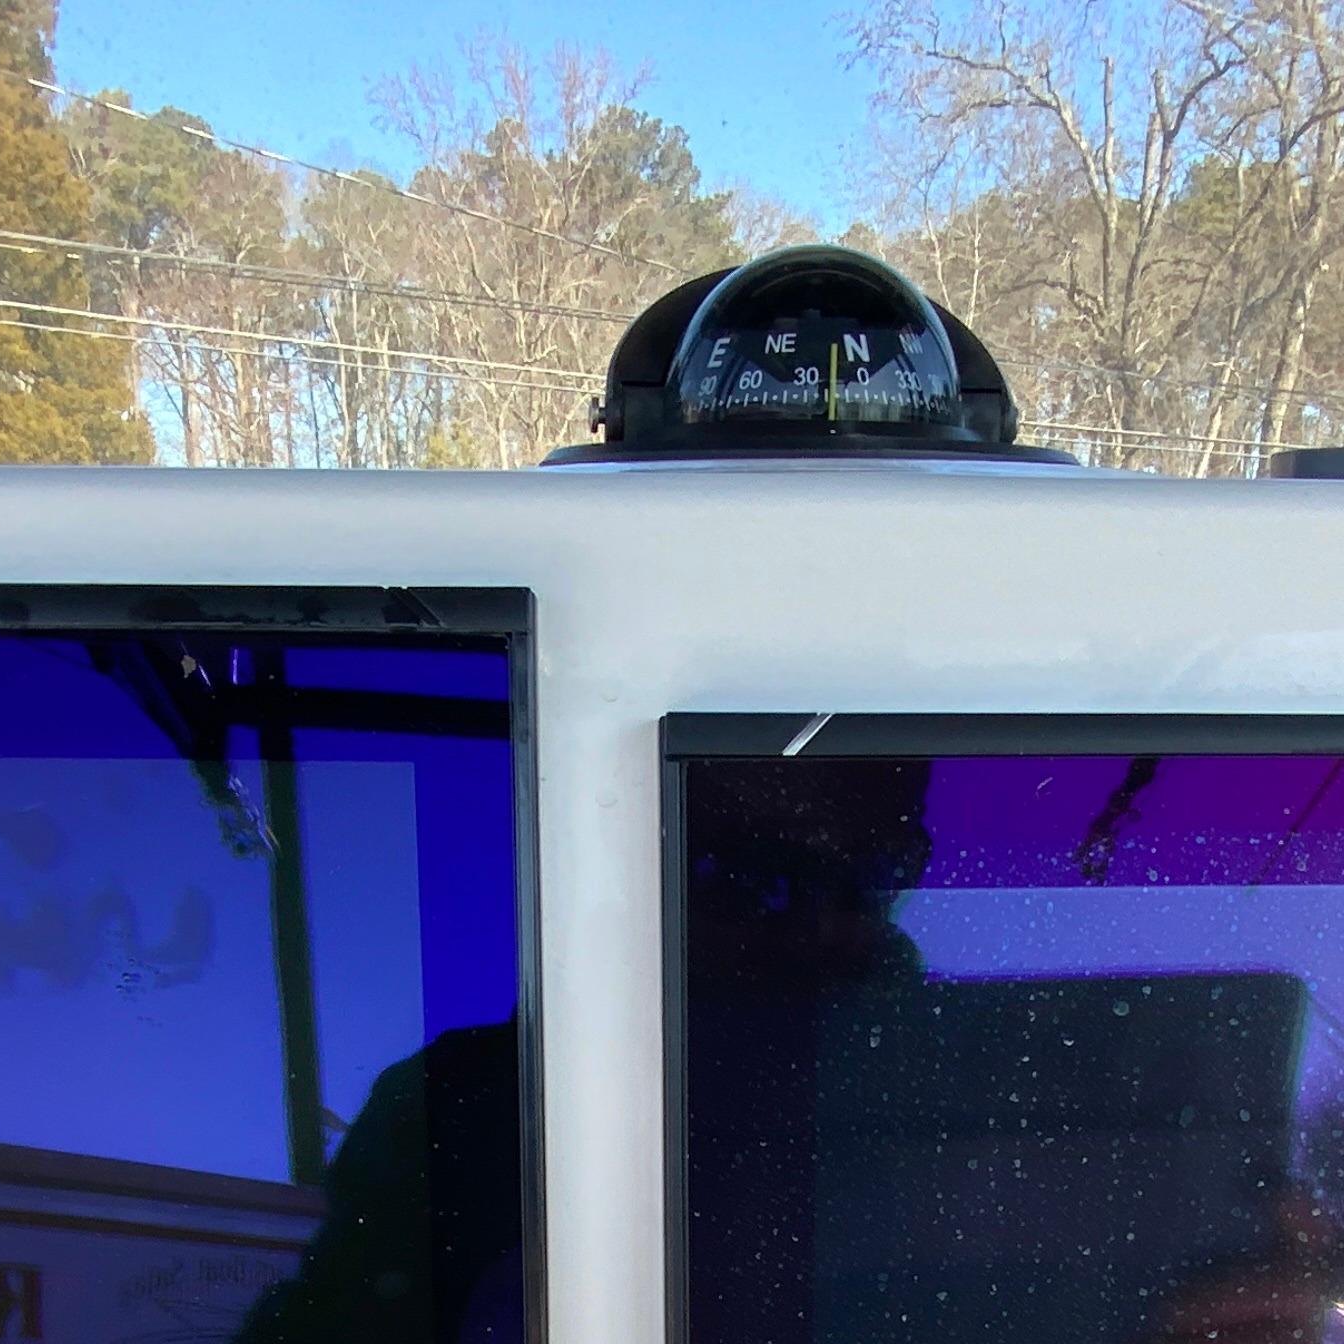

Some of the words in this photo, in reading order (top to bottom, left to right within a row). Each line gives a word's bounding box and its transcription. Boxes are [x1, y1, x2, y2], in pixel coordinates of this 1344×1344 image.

[707, 337, 731, 368] E
[764, 333, 797, 354] NE
[843, 333, 871, 362] N
[739, 370, 763, 389] 60
[794, 367, 819, 385] 30
[857, 368, 870, 385] 0
[894, 370, 922, 391] 330
